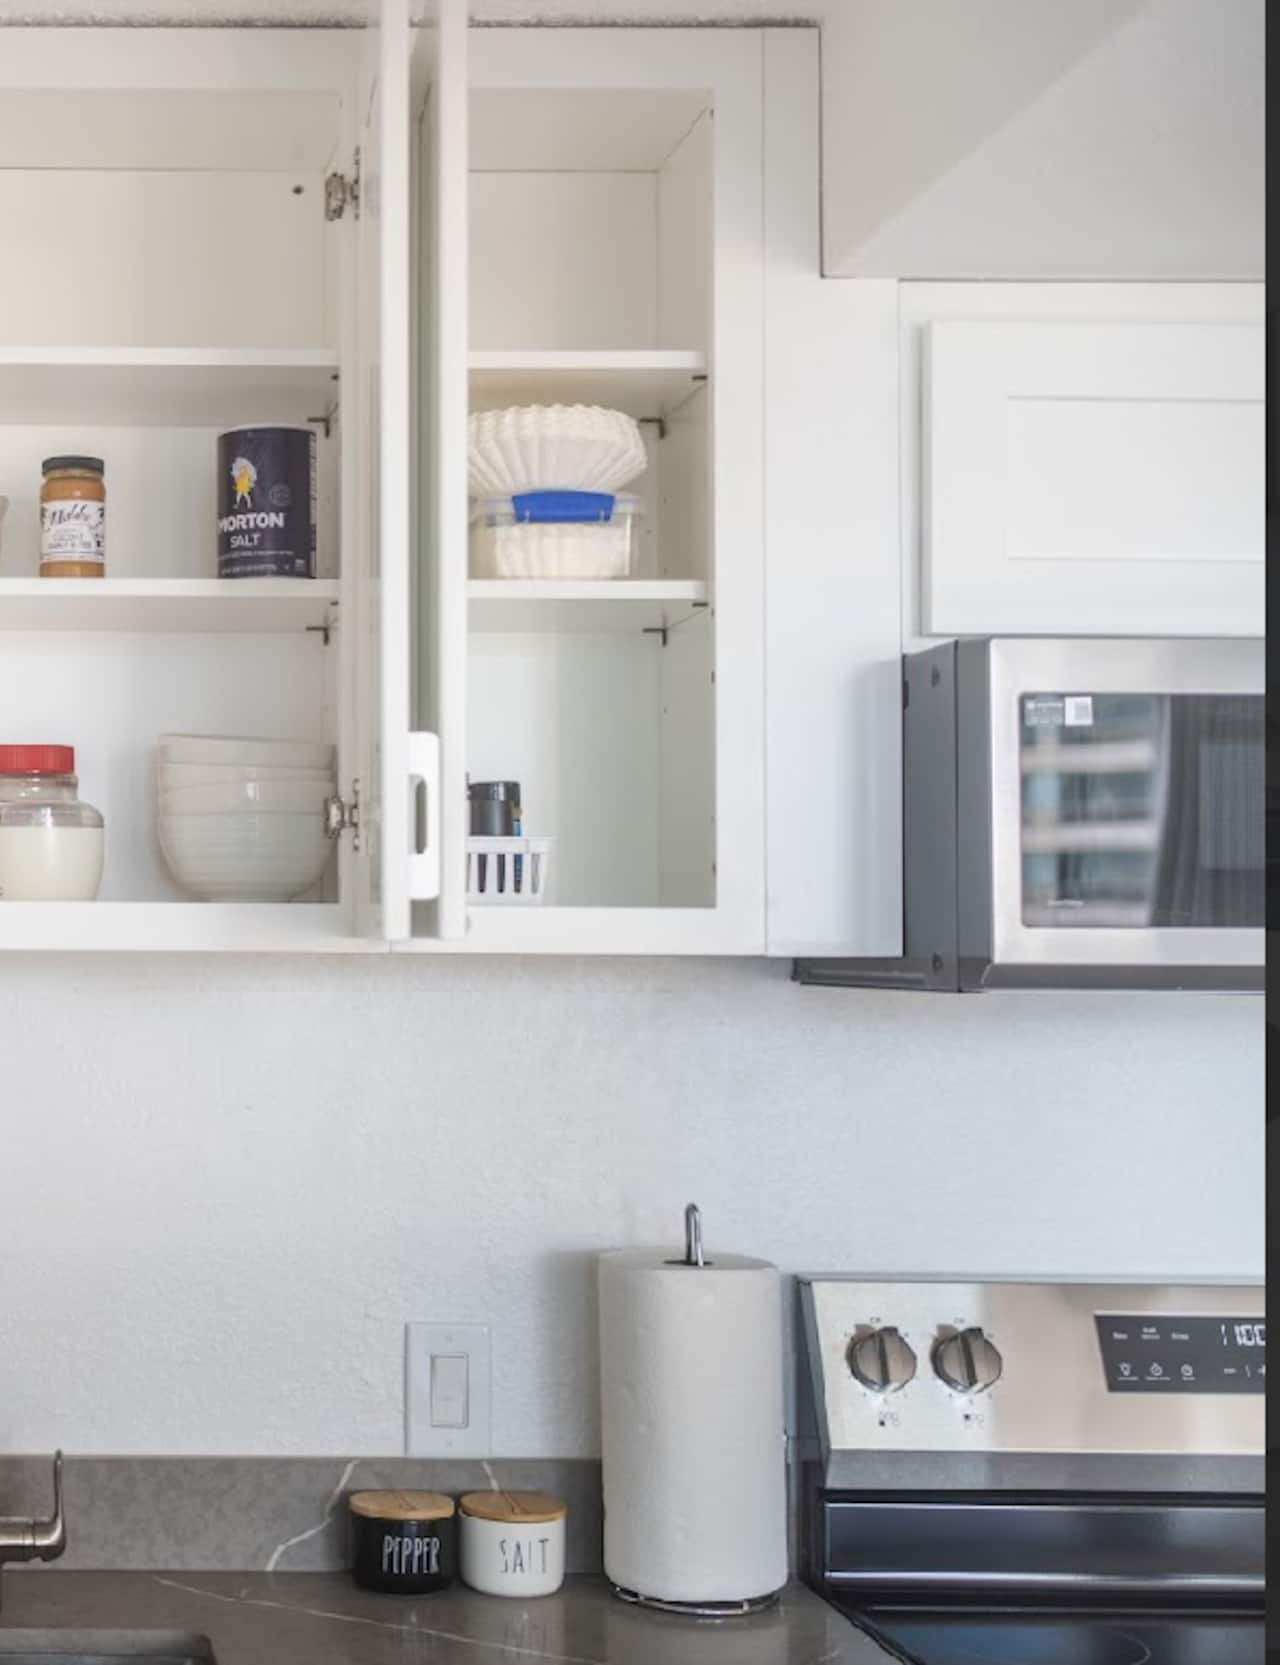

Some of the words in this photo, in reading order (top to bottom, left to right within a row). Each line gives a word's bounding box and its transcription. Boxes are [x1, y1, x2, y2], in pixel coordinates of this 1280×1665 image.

[230, 533, 261, 549] SALT
[382, 1535, 441, 1574] PEPPER
[499, 1538, 550, 1574] SALT
